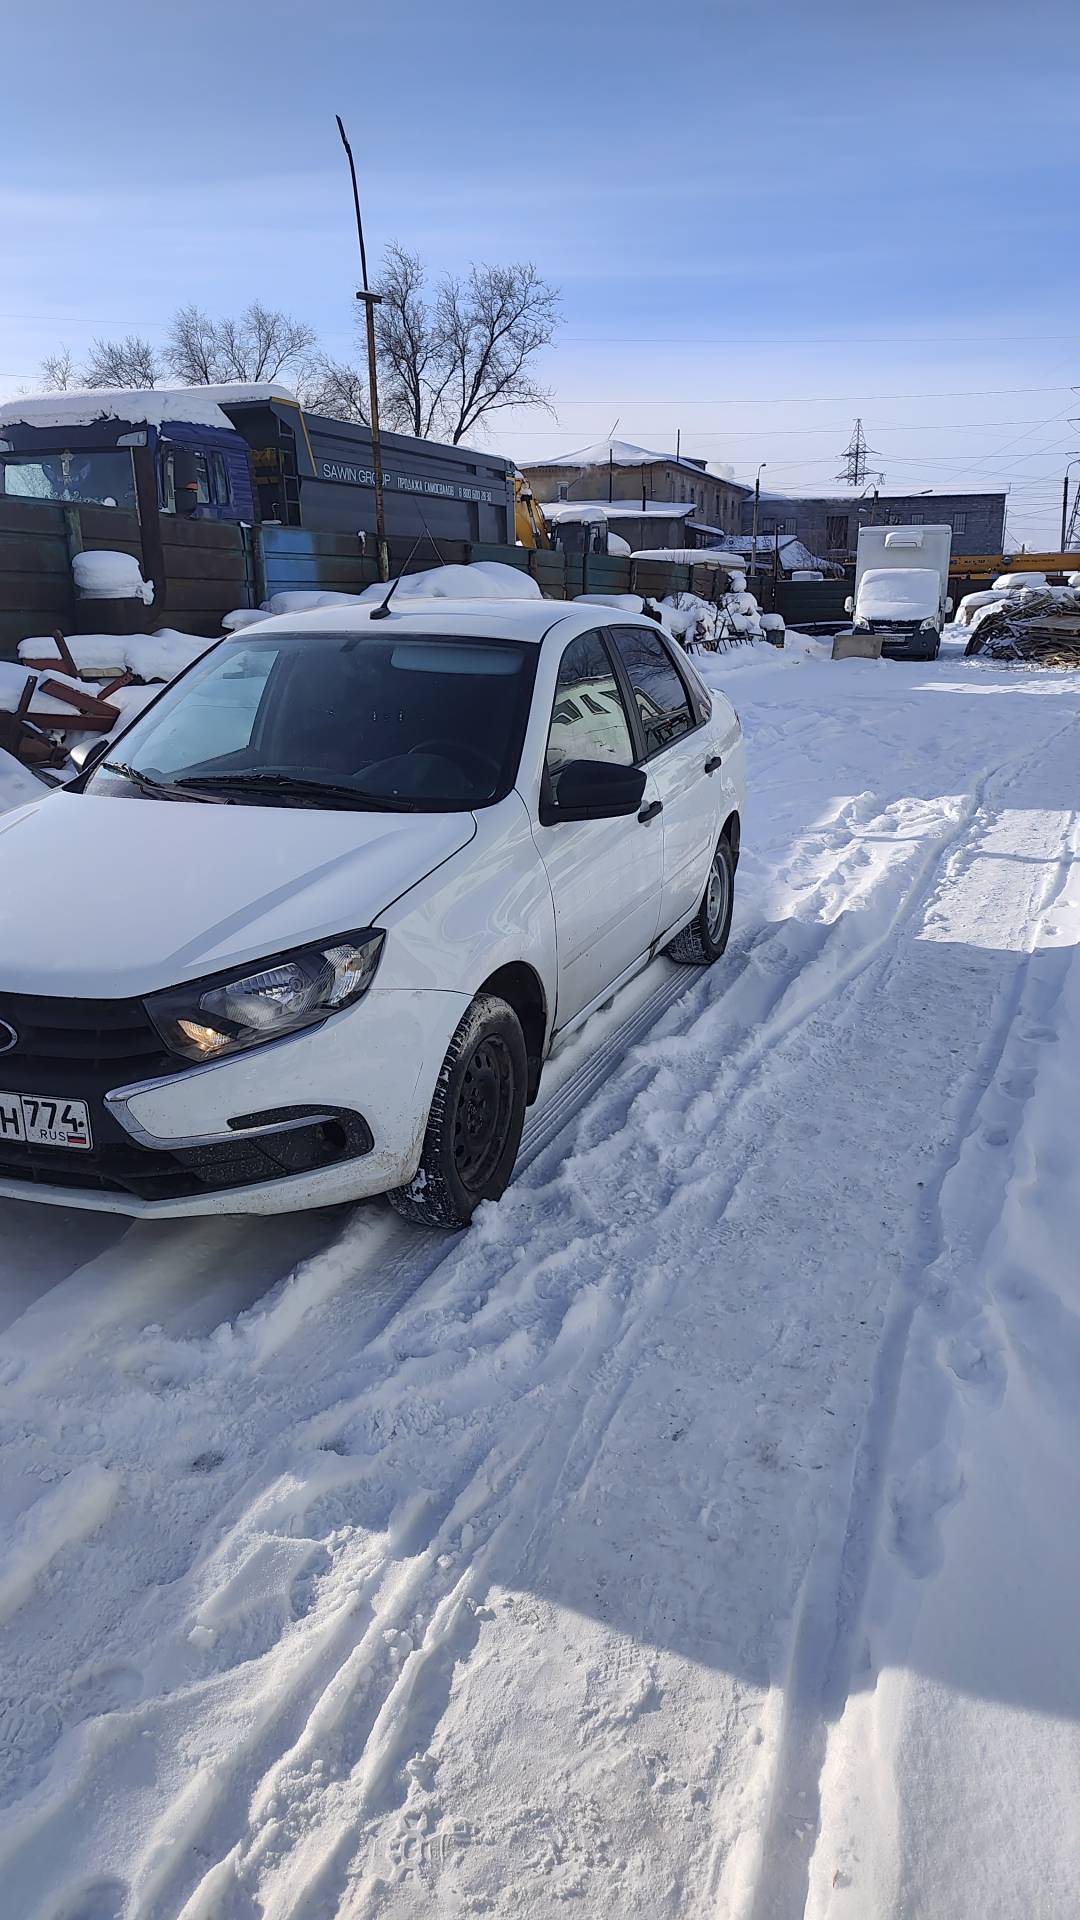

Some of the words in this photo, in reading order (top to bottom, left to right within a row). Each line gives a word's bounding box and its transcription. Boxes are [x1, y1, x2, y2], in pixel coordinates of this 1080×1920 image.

[323, 463, 357, 482] SAWIN
[397, 477, 422, 491] ПРОДАЖА
[458, 487, 462, 497] 8
[463, 488, 471, 499] 800
[23, 1100, 78, 1132] 774
[40, 1129, 67, 1141] RUS
